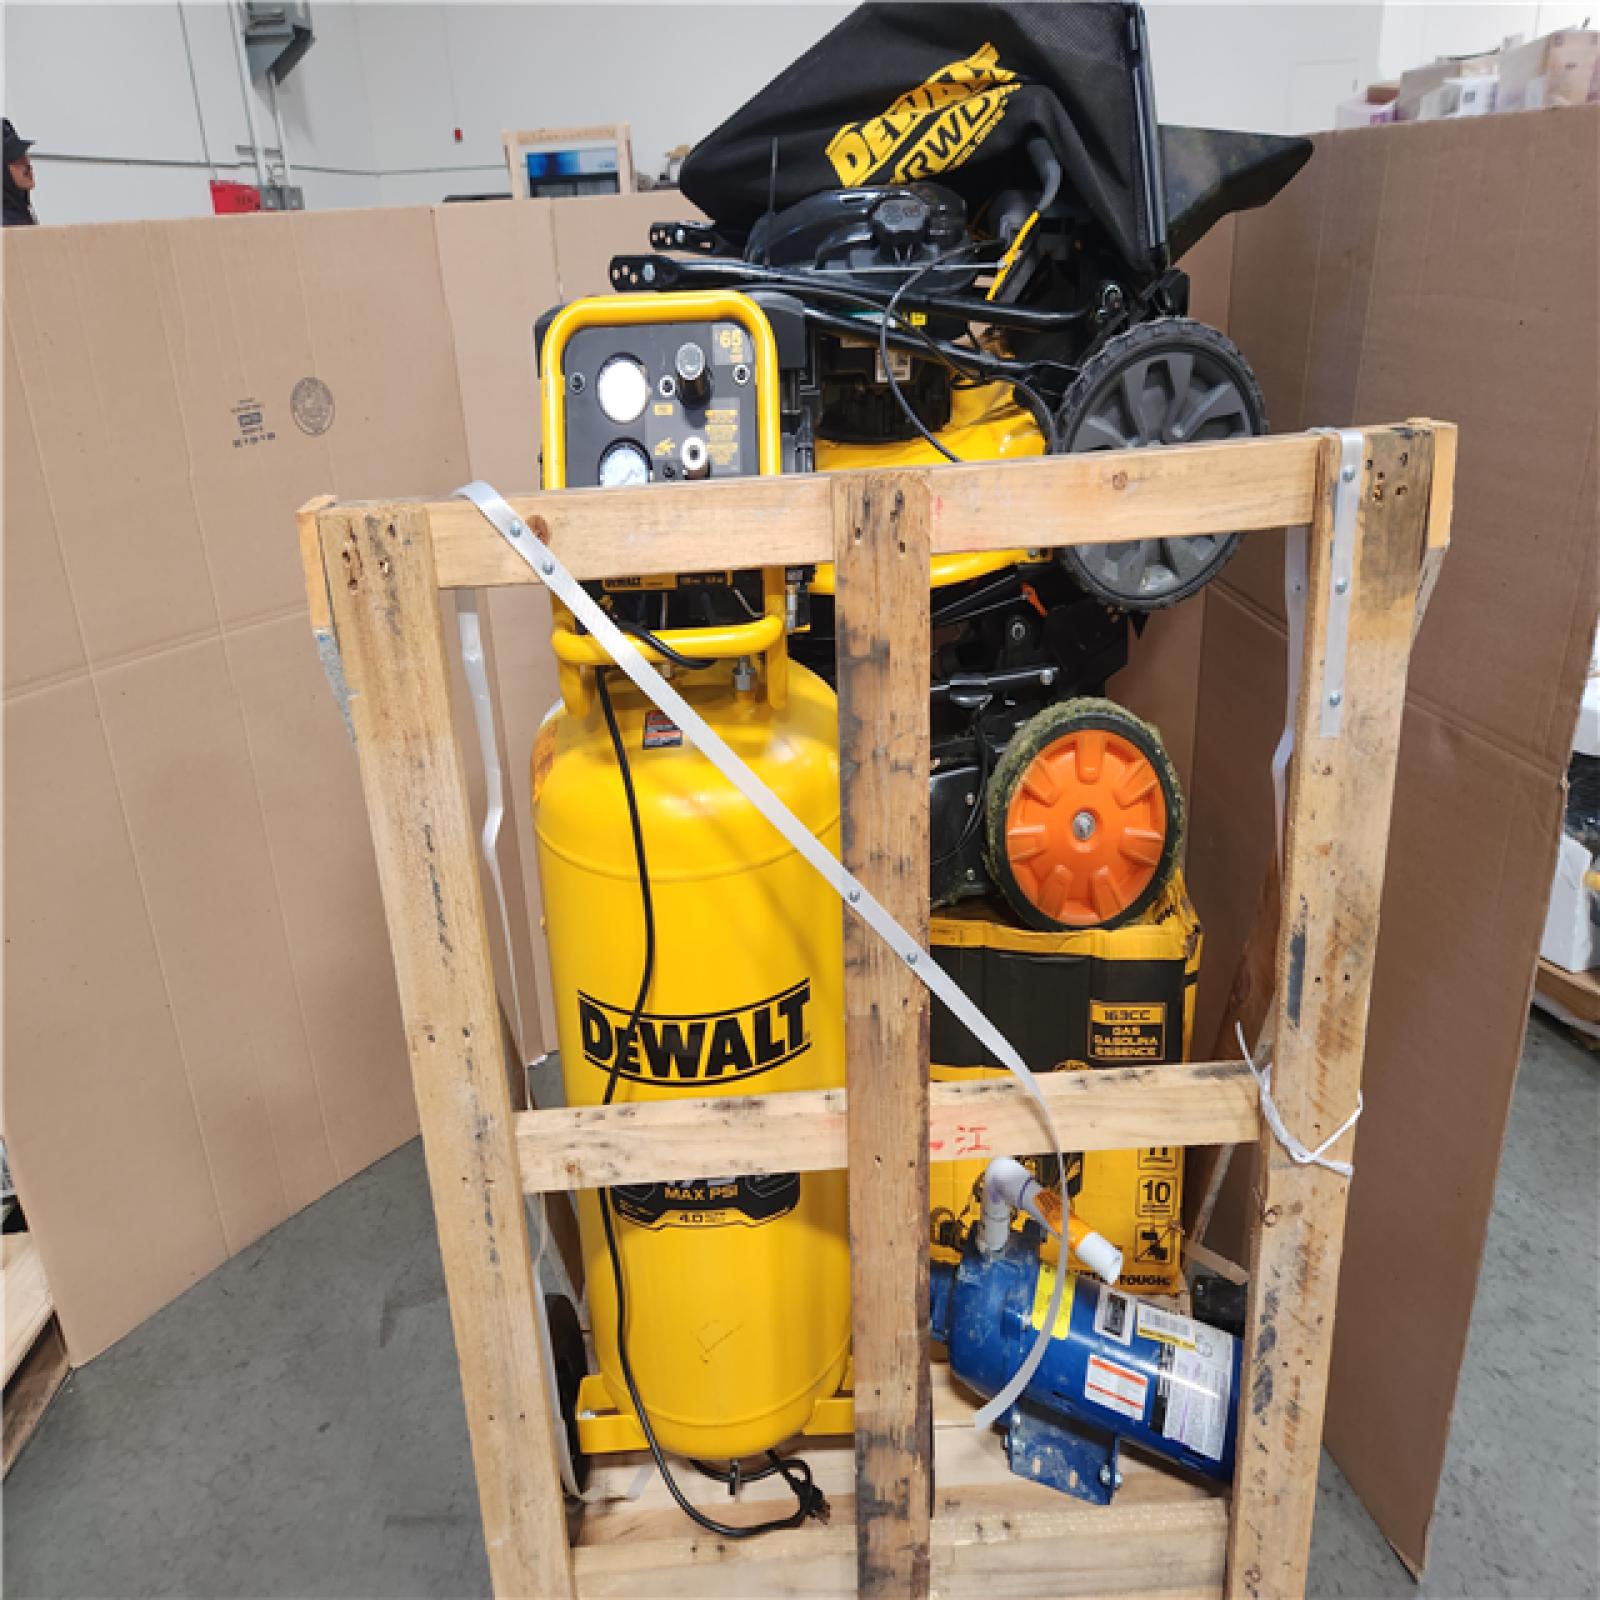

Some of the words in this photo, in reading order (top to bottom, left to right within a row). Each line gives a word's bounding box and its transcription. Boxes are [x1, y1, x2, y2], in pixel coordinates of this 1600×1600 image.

[579, 983, 811, 1078] DEWALT
[664, 1186, 706, 1201] MAX
[709, 1184, 739, 1200] PSI
[1142, 1179, 1171, 1203] 10
